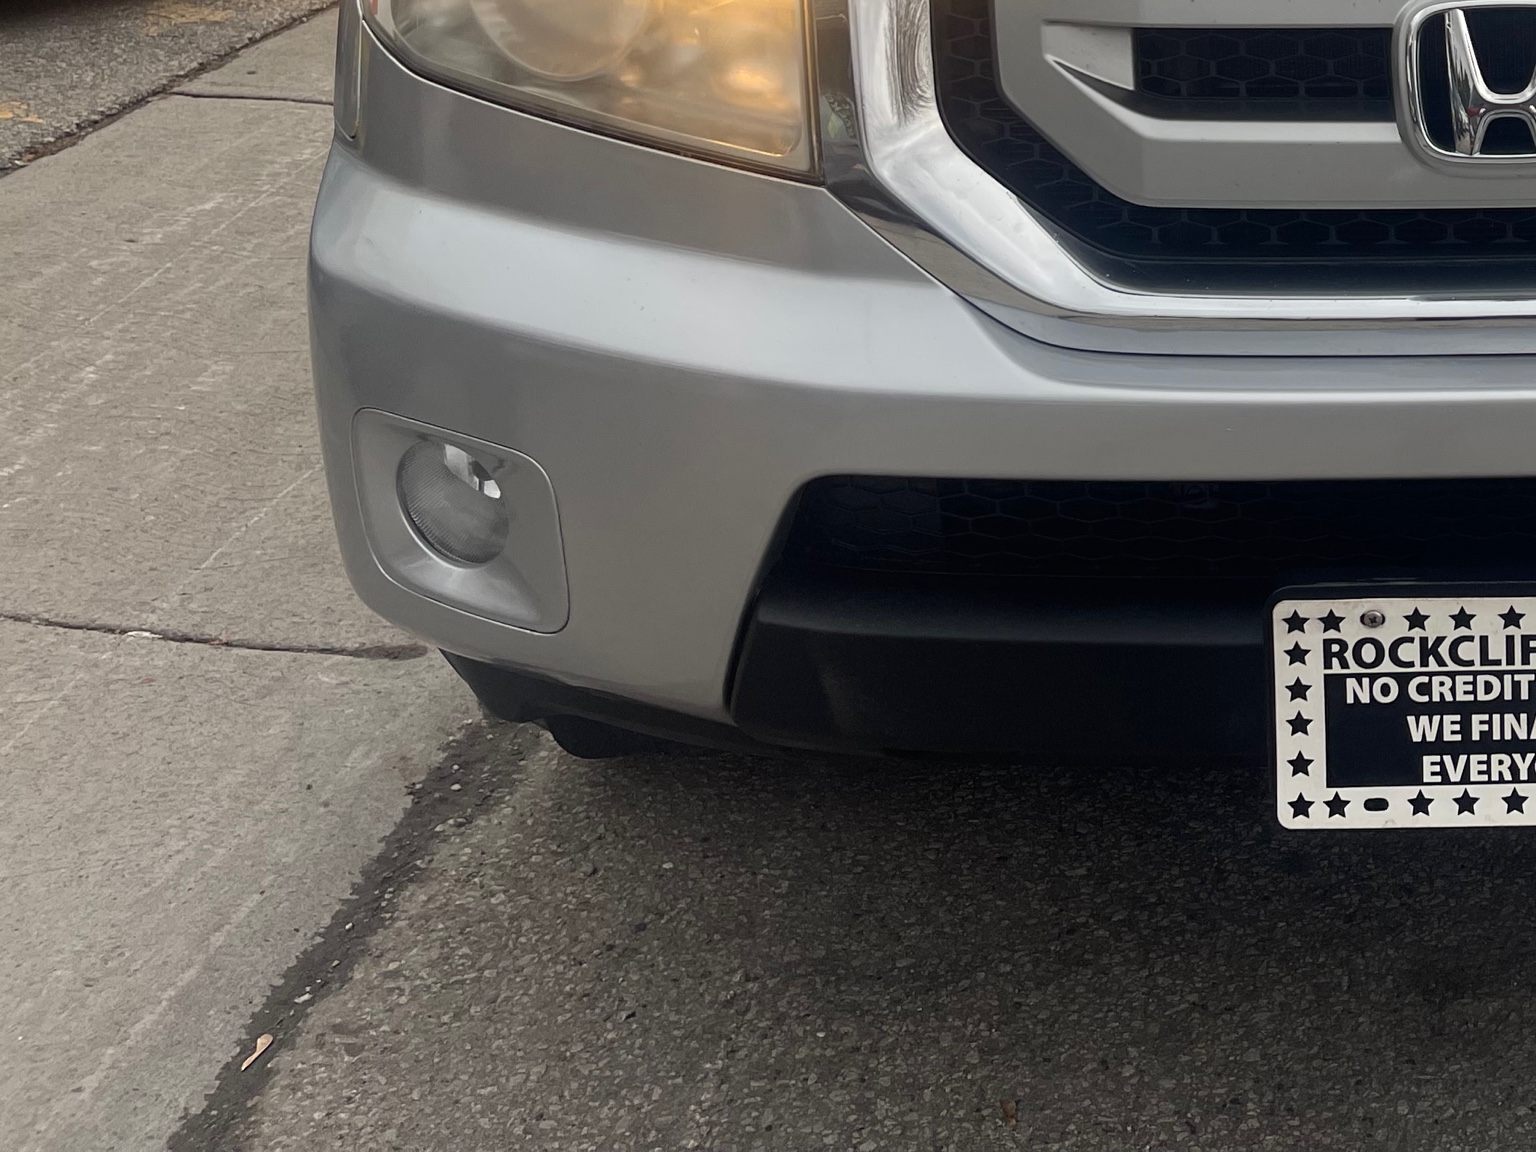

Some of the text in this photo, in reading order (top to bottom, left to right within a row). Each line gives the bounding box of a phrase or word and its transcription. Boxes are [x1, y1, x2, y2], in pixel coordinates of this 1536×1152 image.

[1345, 675, 1399, 705] NO
[1406, 673, 1536, 704] CREDIT
[1407, 715, 1466, 743] WE
